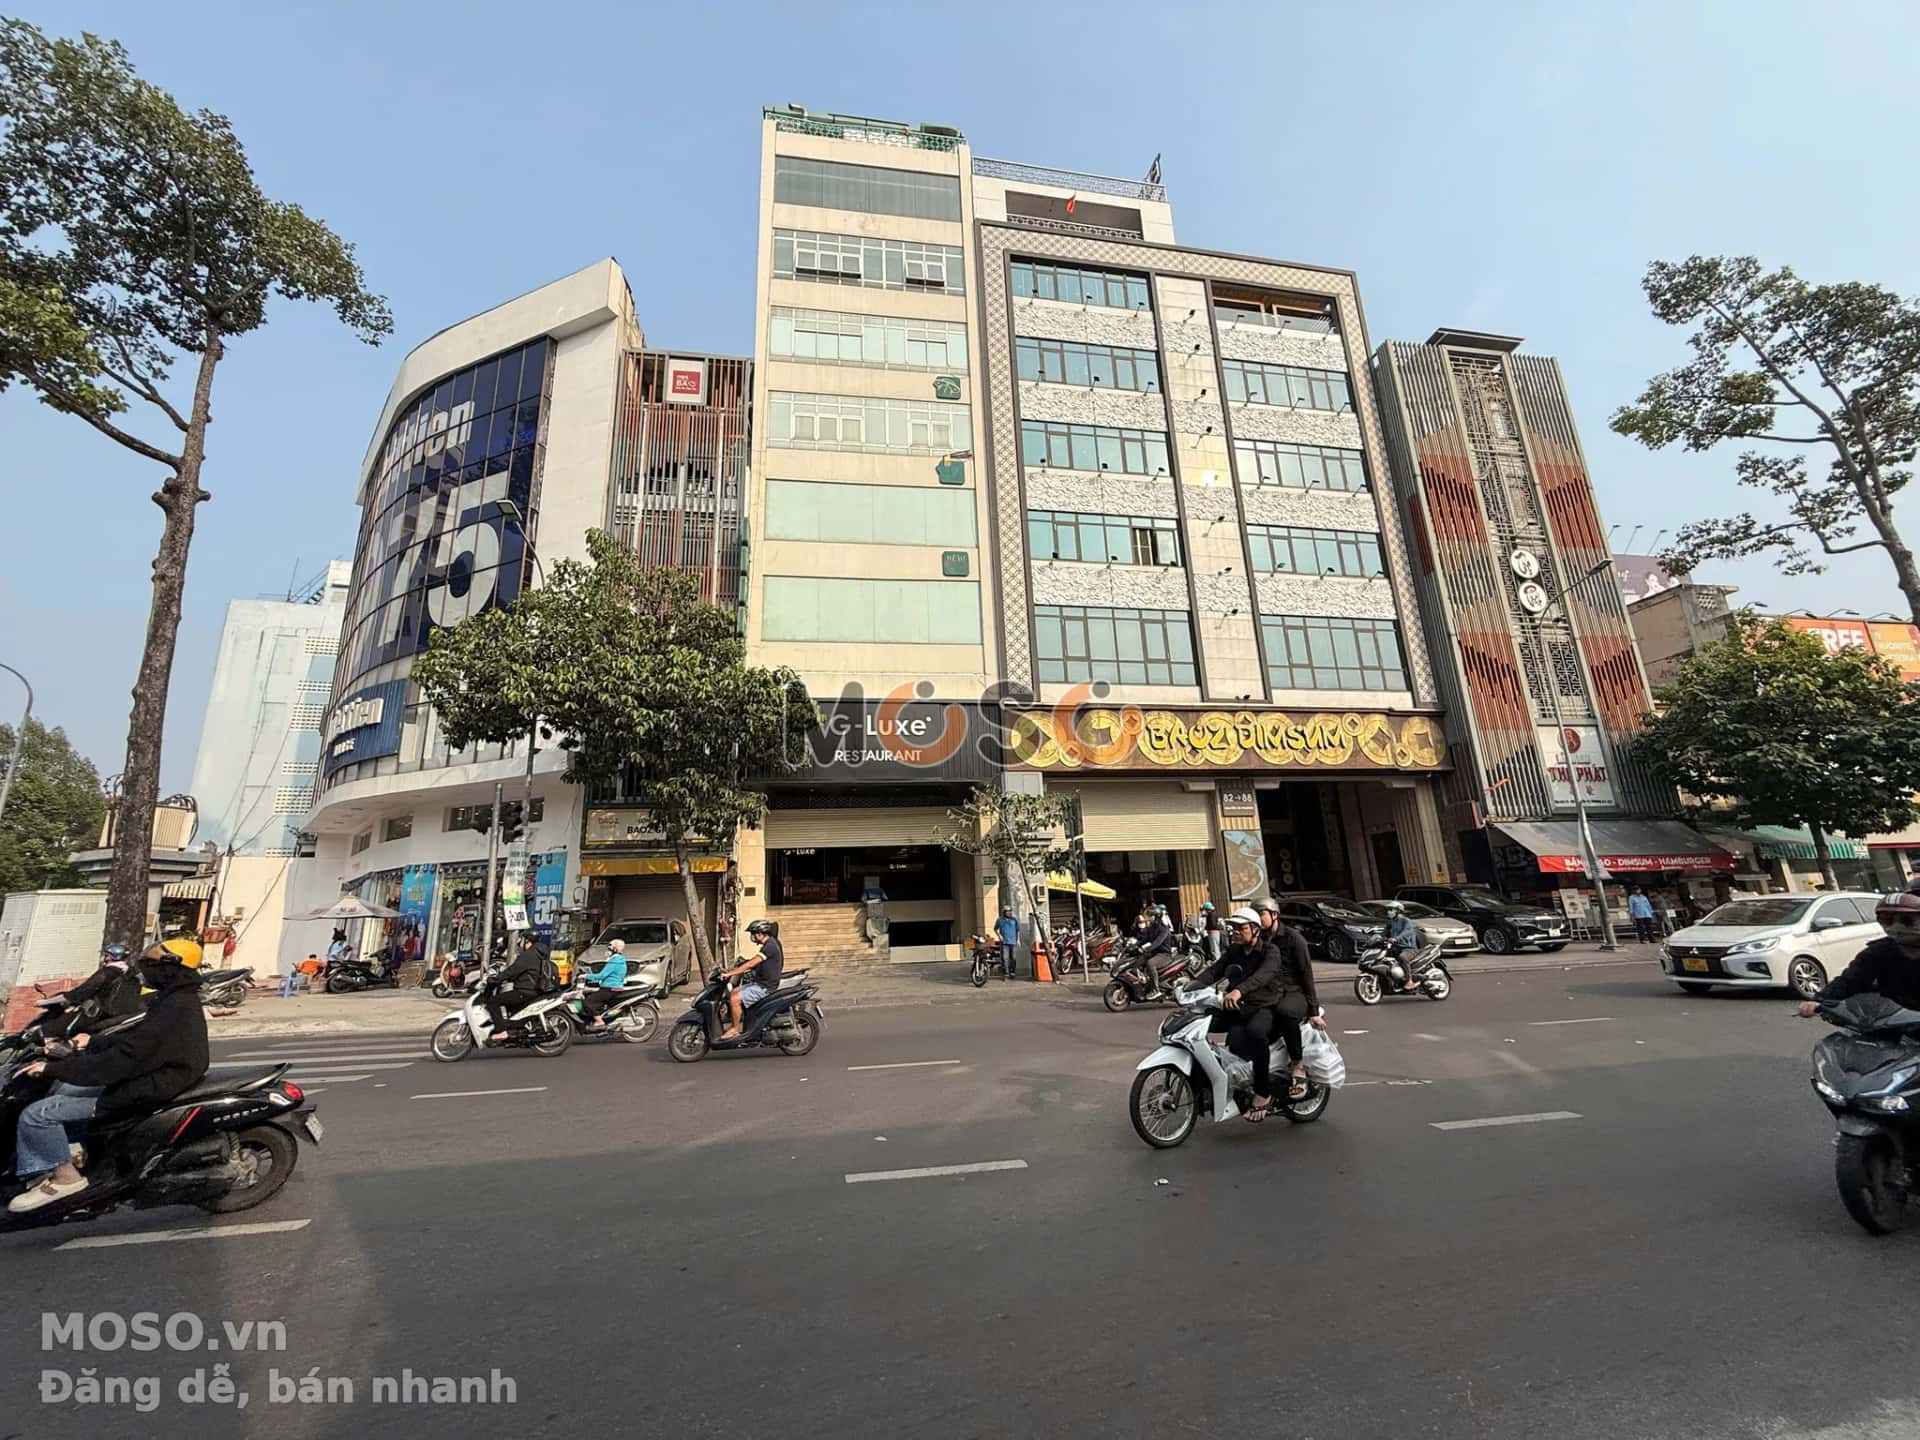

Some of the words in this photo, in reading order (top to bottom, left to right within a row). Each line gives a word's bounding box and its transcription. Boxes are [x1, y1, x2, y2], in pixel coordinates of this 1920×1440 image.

[834, 750, 923, 762] RESTAURANT
[1618, 858, 1653, 866] DIMSUM
[1659, 856, 1712, 865] HAMBURGER
